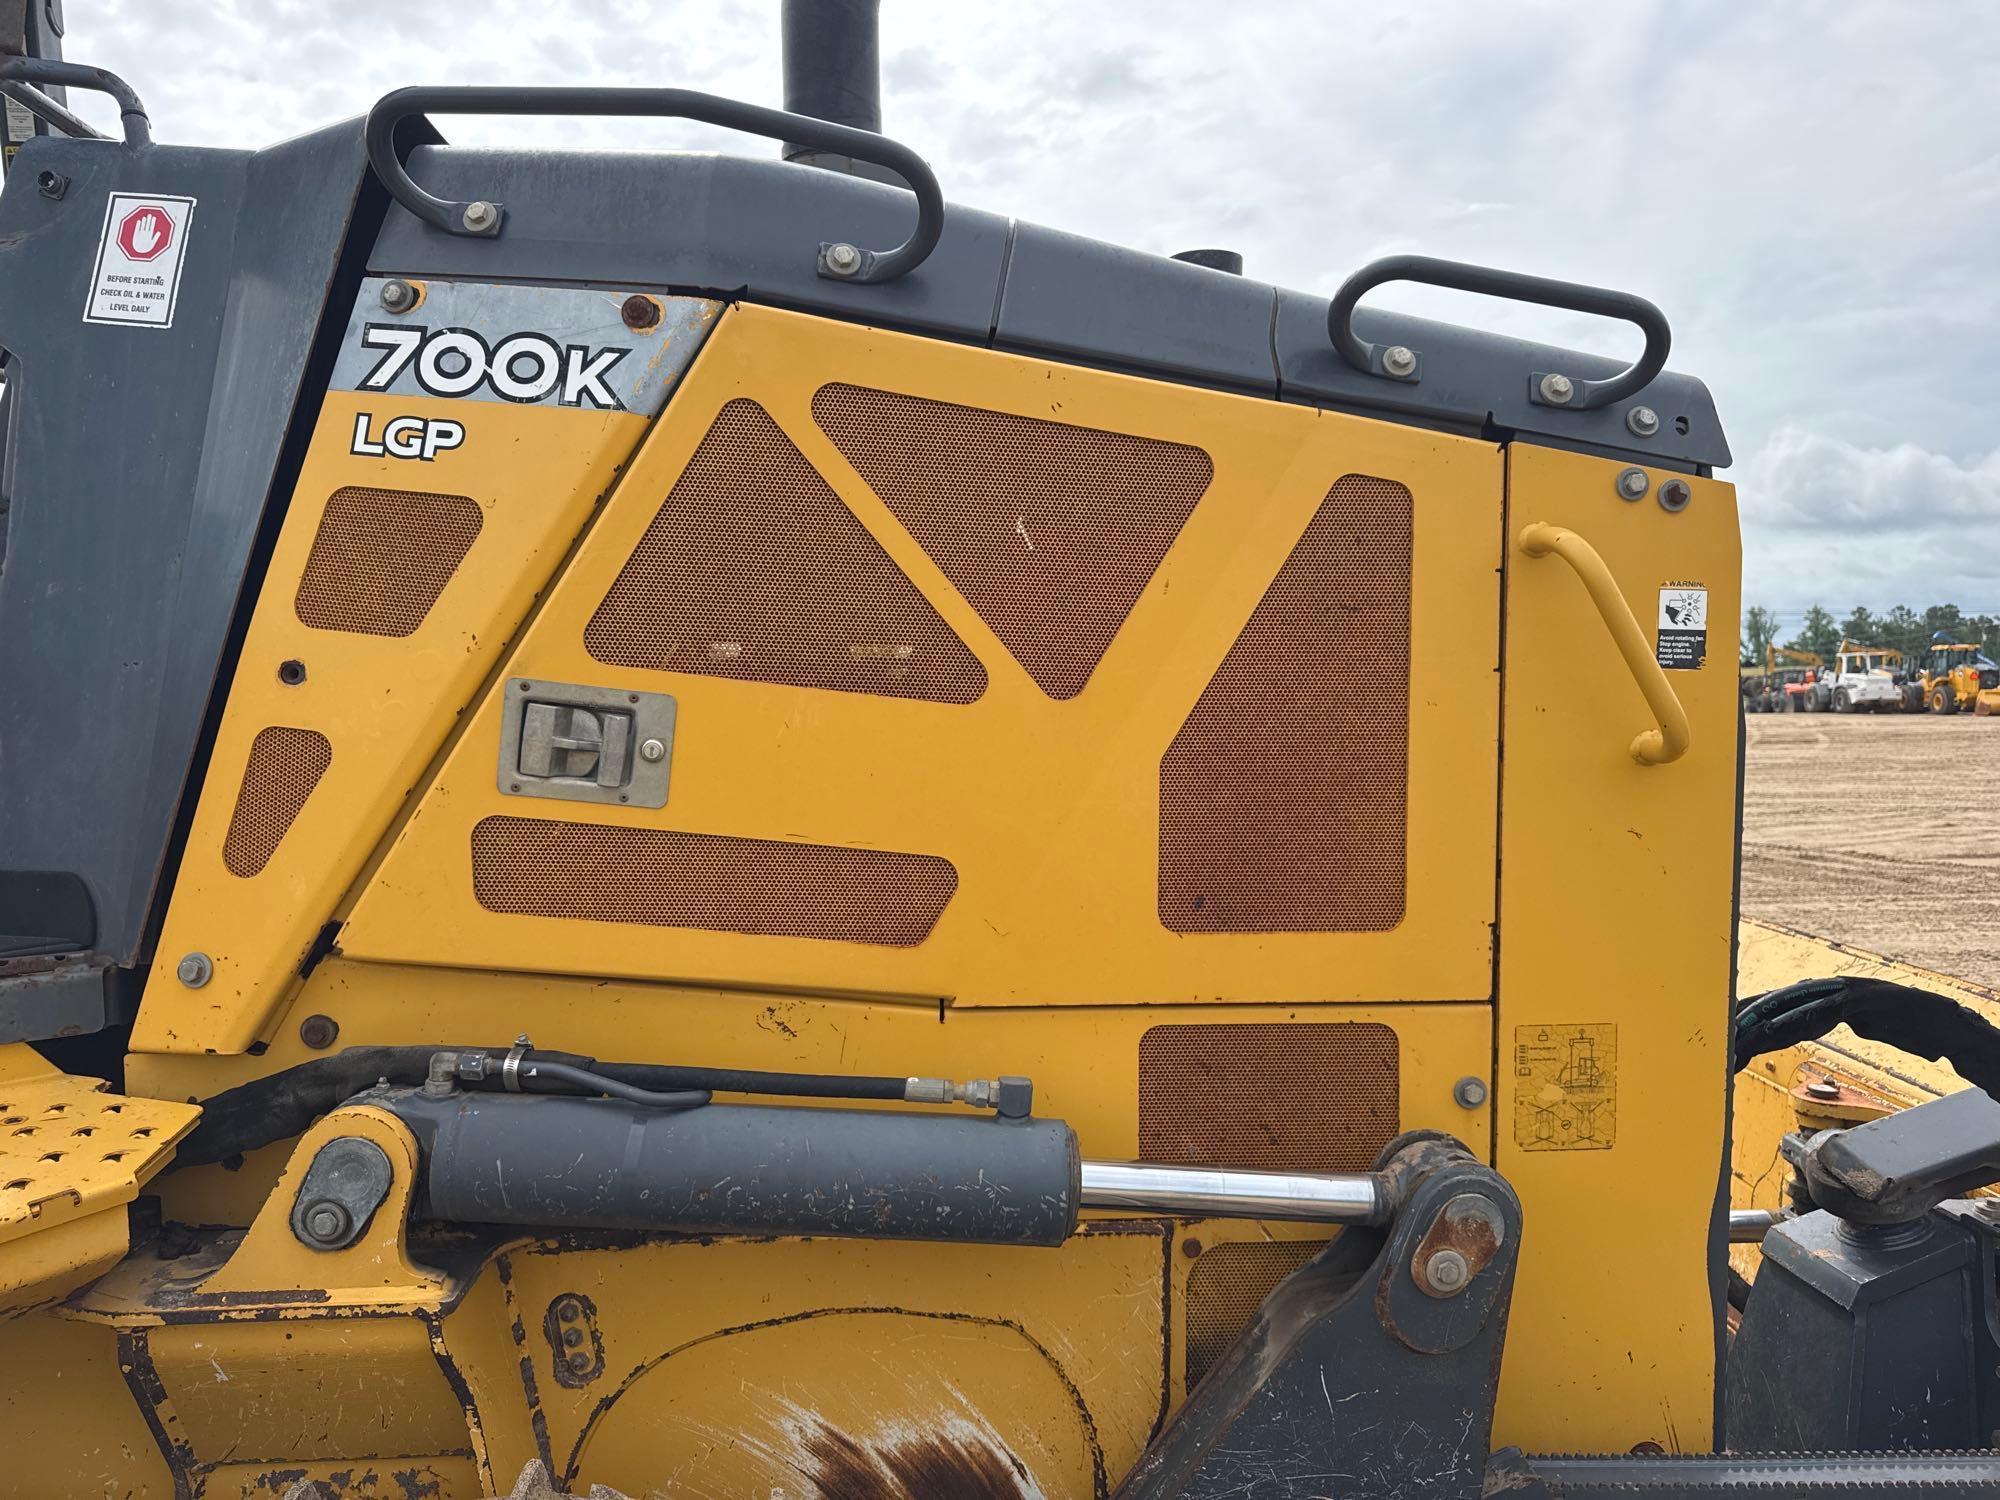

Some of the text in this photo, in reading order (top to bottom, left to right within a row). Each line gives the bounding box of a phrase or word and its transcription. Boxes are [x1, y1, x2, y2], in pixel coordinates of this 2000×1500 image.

[107, 275, 164, 286] BEFORE STARTING
[100, 288, 122, 297] CHECK
[123, 290, 134, 298] OIL
[143, 292, 165, 300] WATER
[110, 303, 150, 313] LEVEL DAILY
[355, 321, 633, 412] 700K
[350, 412, 466, 462] LGP
